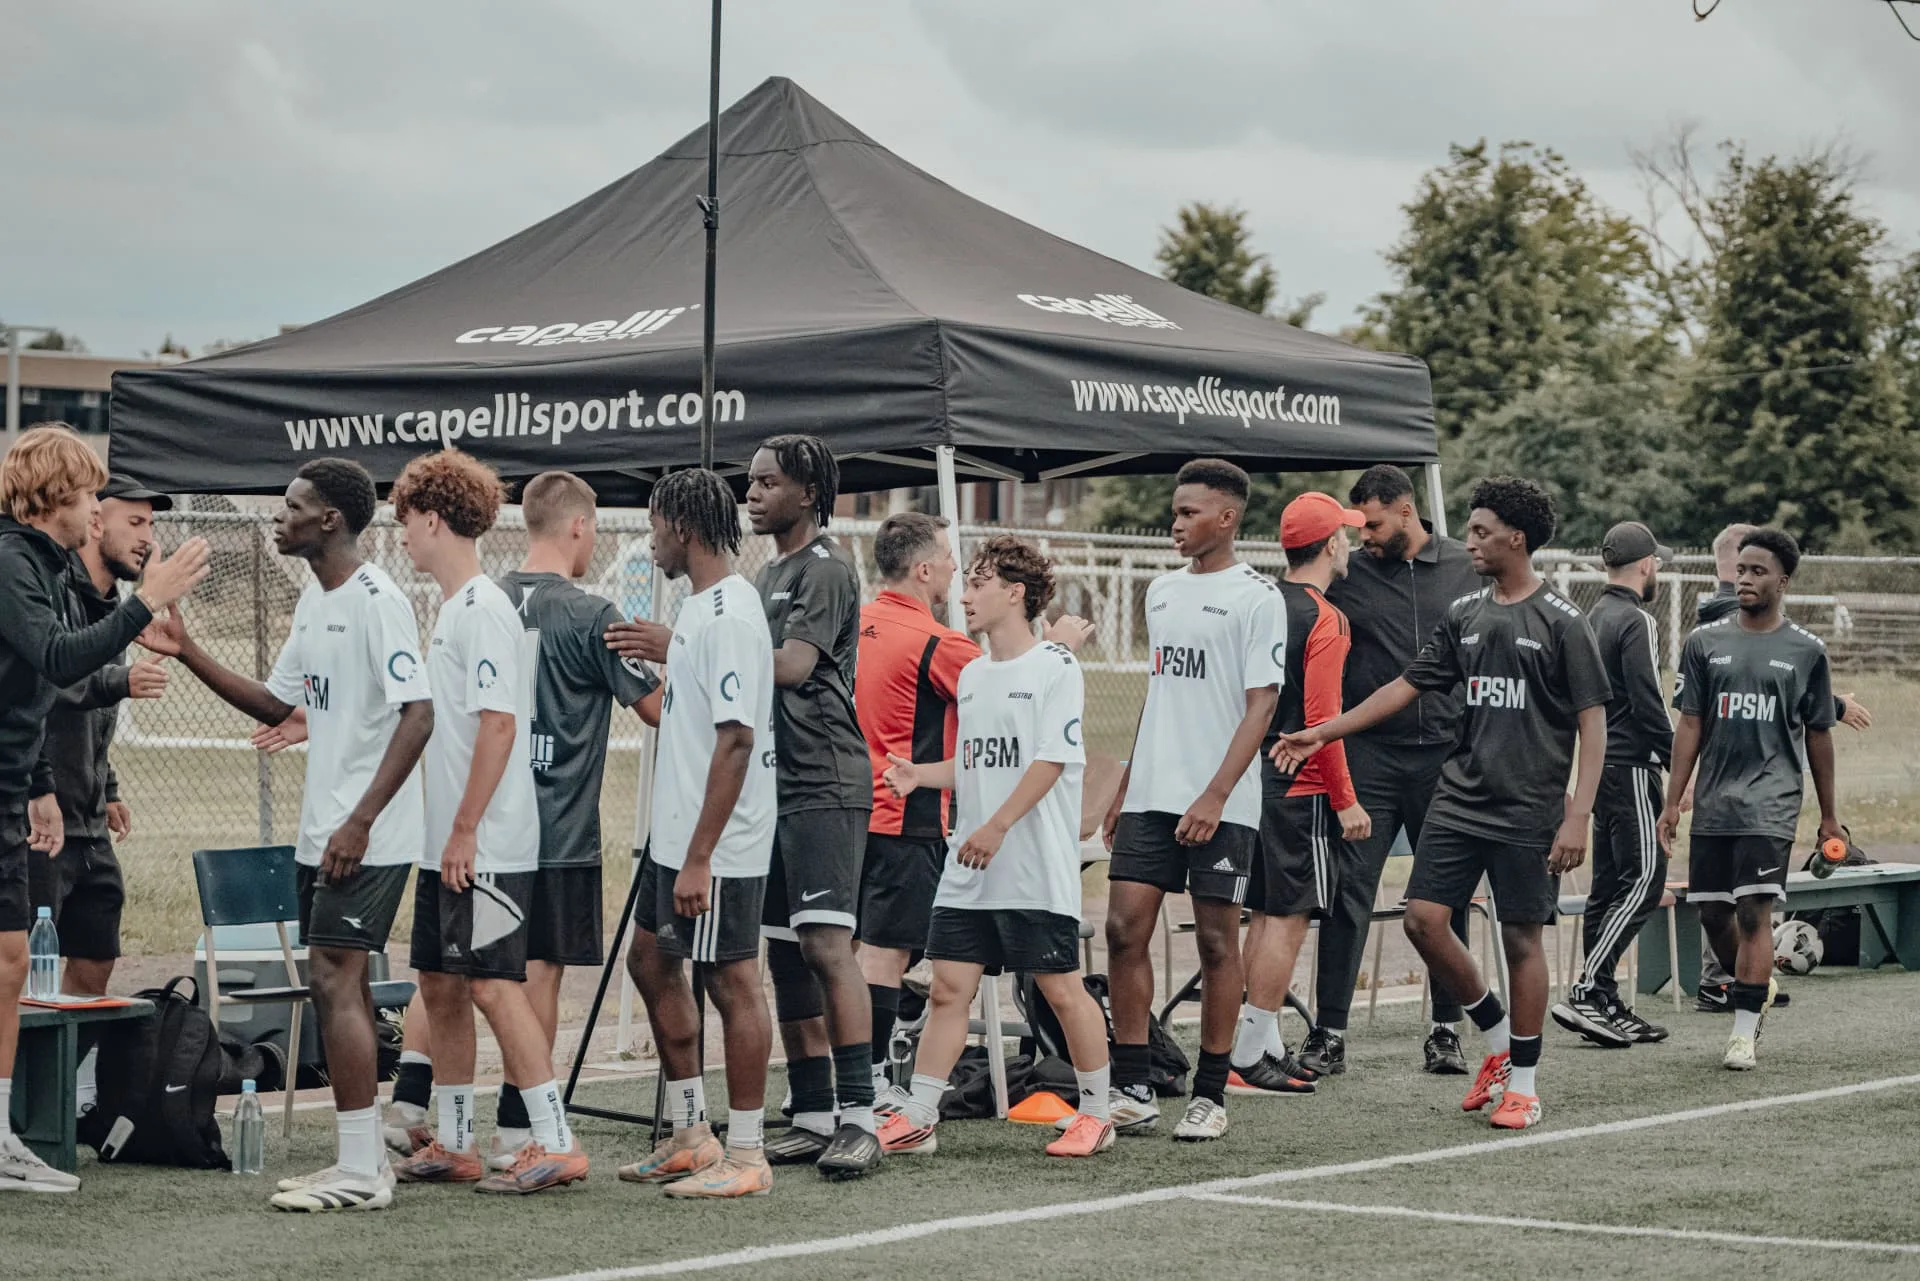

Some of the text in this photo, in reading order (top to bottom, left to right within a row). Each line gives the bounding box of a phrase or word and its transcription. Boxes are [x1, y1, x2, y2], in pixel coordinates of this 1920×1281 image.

[455, 306, 687, 346] capelli
[1016, 293, 1168, 323] capelli
[532, 330, 653, 347] SPORT
[284, 389, 746, 452] www.capellisport.com
[1070, 376, 1341, 428] www.capellisport.com
